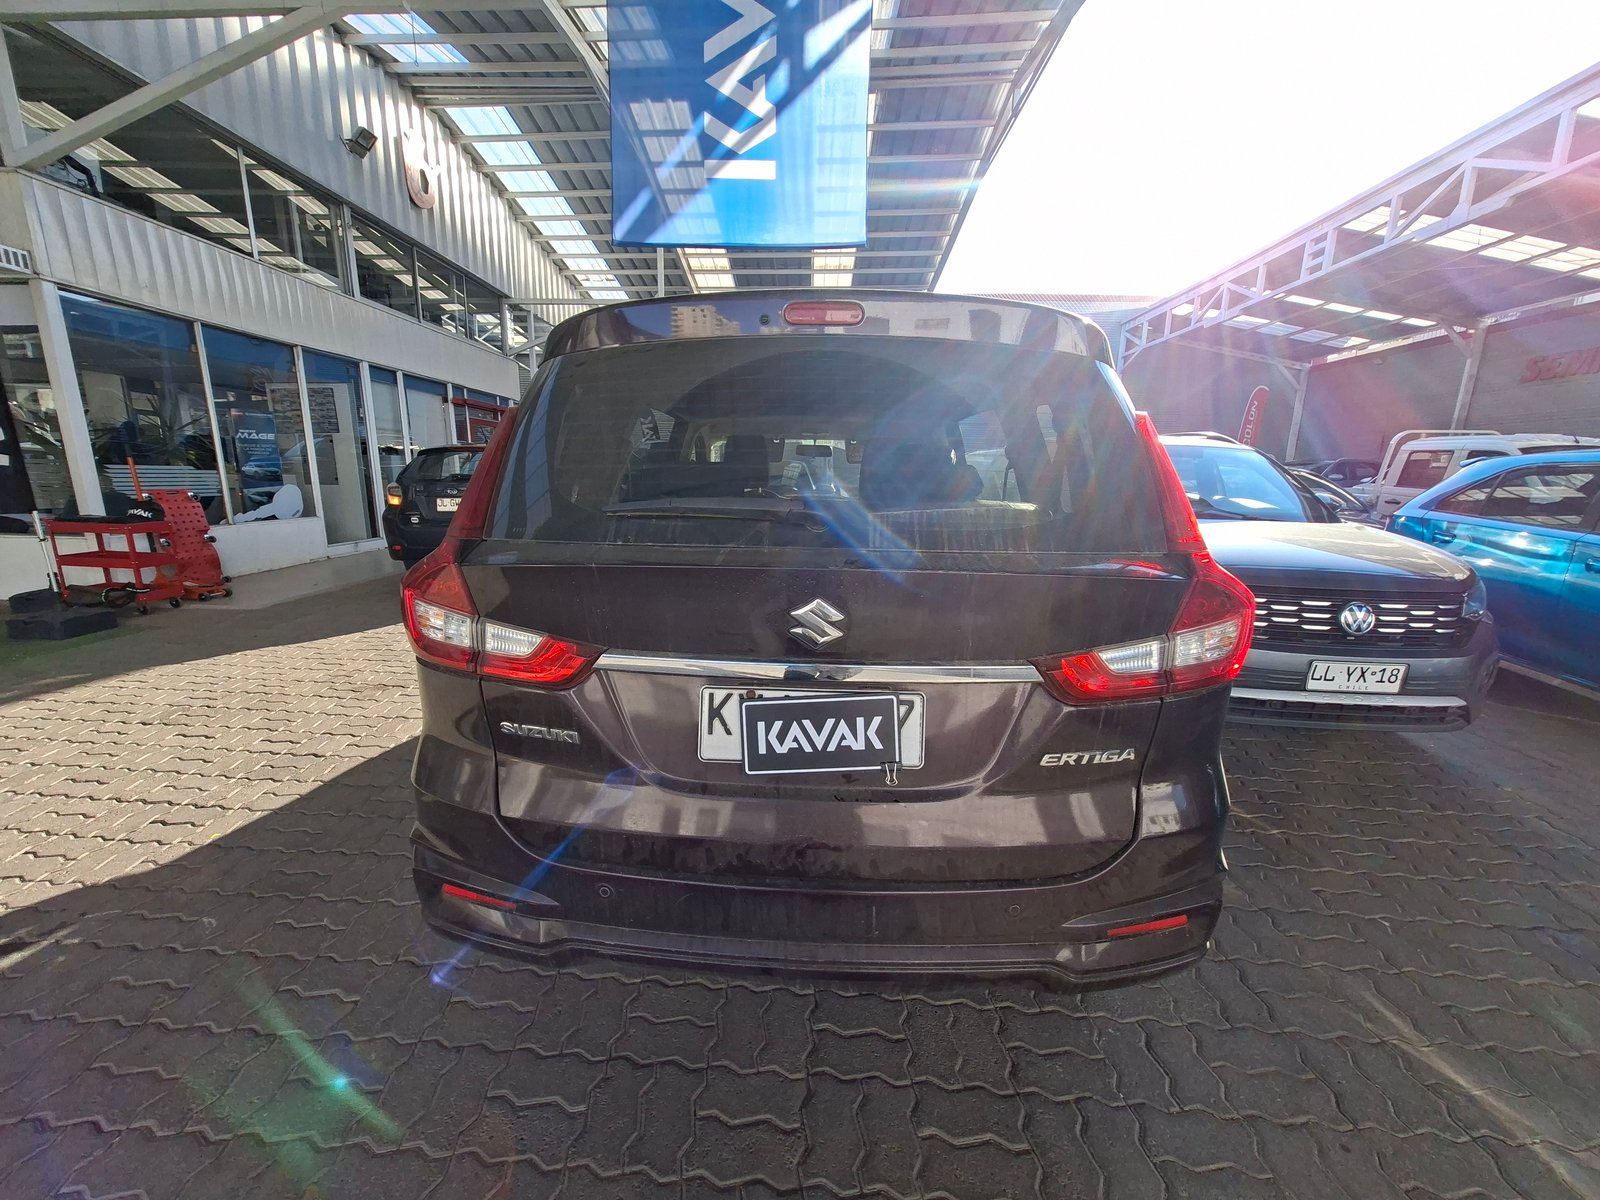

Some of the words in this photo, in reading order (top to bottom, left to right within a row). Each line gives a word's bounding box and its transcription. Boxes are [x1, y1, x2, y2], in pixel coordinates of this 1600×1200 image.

[236, 432, 276, 440] MAGE
[499, 721, 580, 745] SUZUKI
[756, 715, 884, 755] KAVAK
[1039, 748, 1135, 767] ERTIGA
